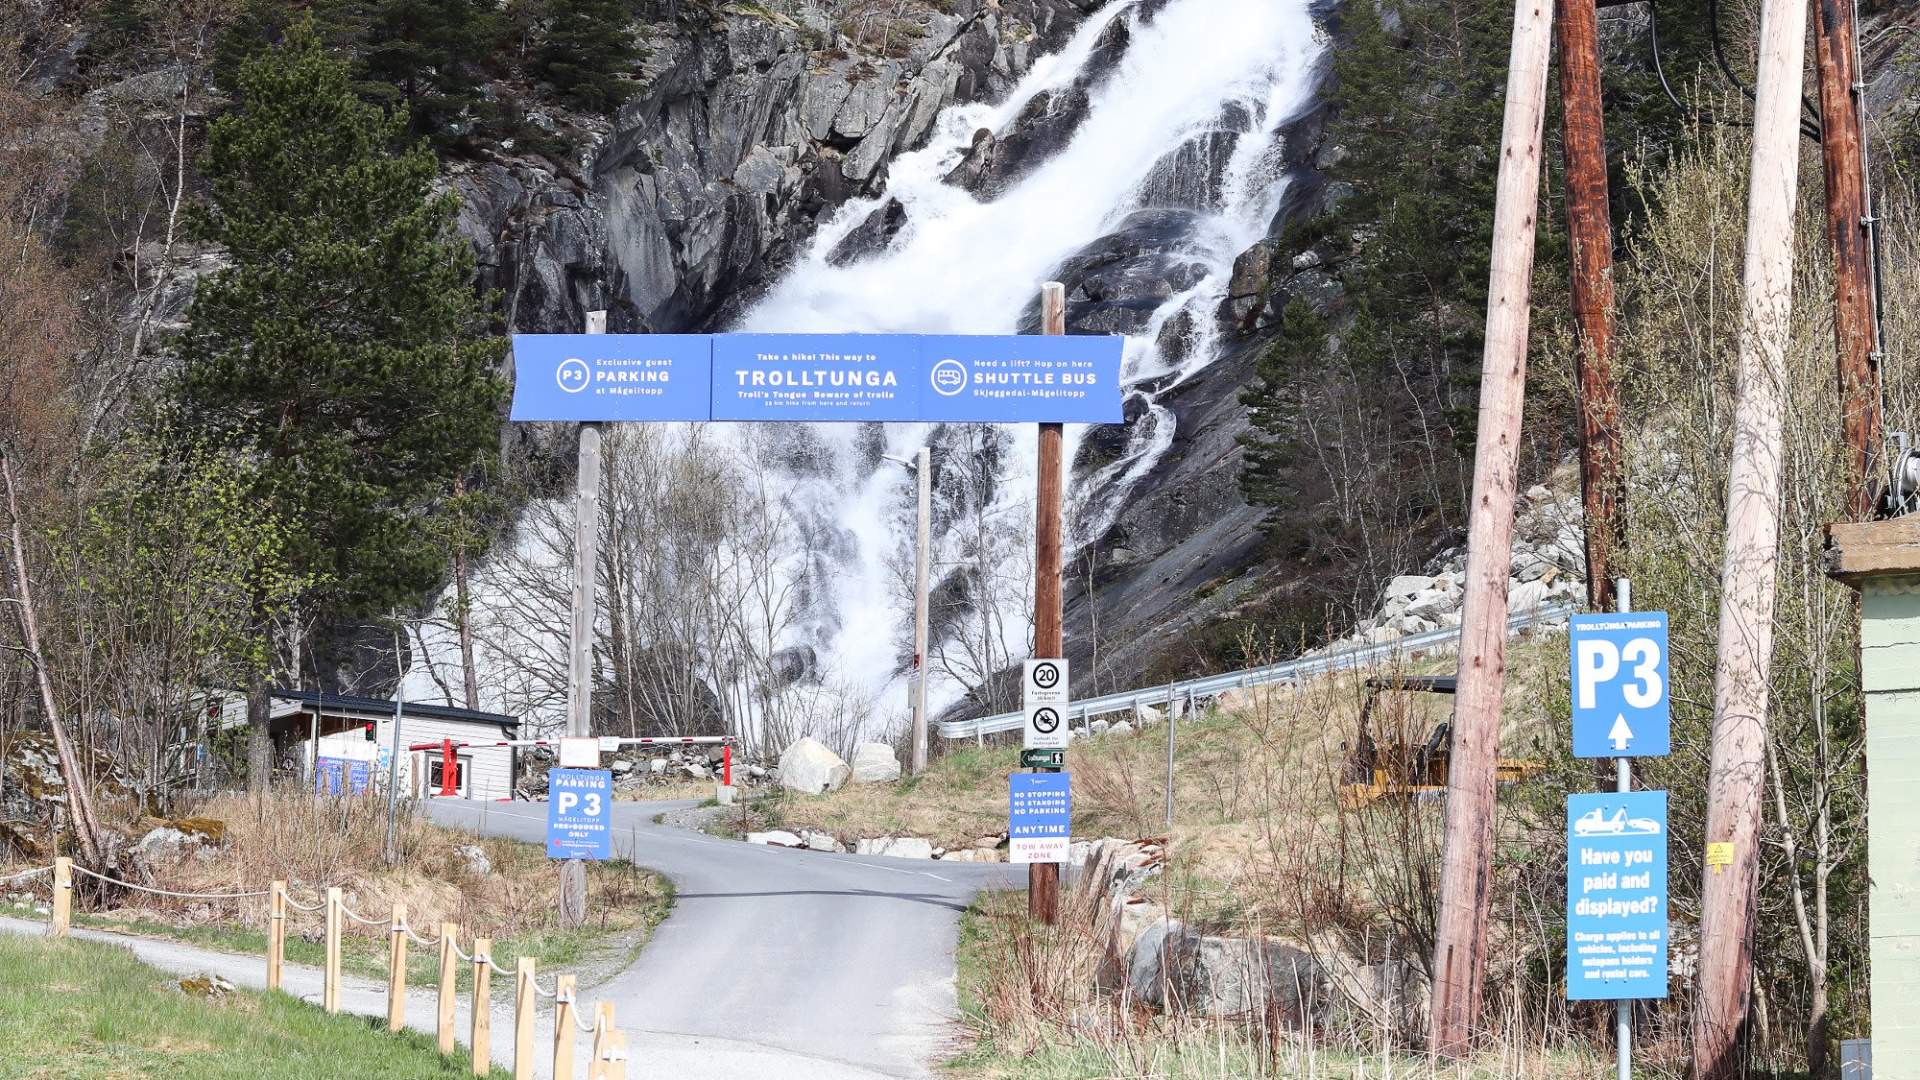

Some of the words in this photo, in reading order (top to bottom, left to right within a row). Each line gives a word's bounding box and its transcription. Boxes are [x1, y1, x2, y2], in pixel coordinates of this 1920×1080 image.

[646, 359, 673, 367] guest
[596, 371, 670, 382] PARKING
[735, 371, 898, 386] TROLLTUNGA
[974, 373, 1055, 384] SHUTTLE
[1062, 373, 1097, 385] BUS
[596, 387, 605, 395] at
[738, 391, 769, 399] Troll's
[773, 391, 807, 399] Tongue
[814, 391, 850, 399] Beware
[853, 391, 864, 399] of
[867, 391, 894, 399] trolls
[1039, 669, 1054, 682] 20
[1578, 638, 1663, 710] P3
[556, 779, 606, 788] PARKING
[1015, 825, 1065, 834] ANYTIME
[1581, 848, 1620, 865] Have
[1625, 849, 1653, 867] you
[1584, 873, 1617, 893] paid
[1621, 872, 1650, 889] and
[1575, 897, 1658, 919] displayed?
[1575, 932, 1604, 943] Charge
[1638, 932, 1647, 940] to
[1584, 970, 1600, 978] and
